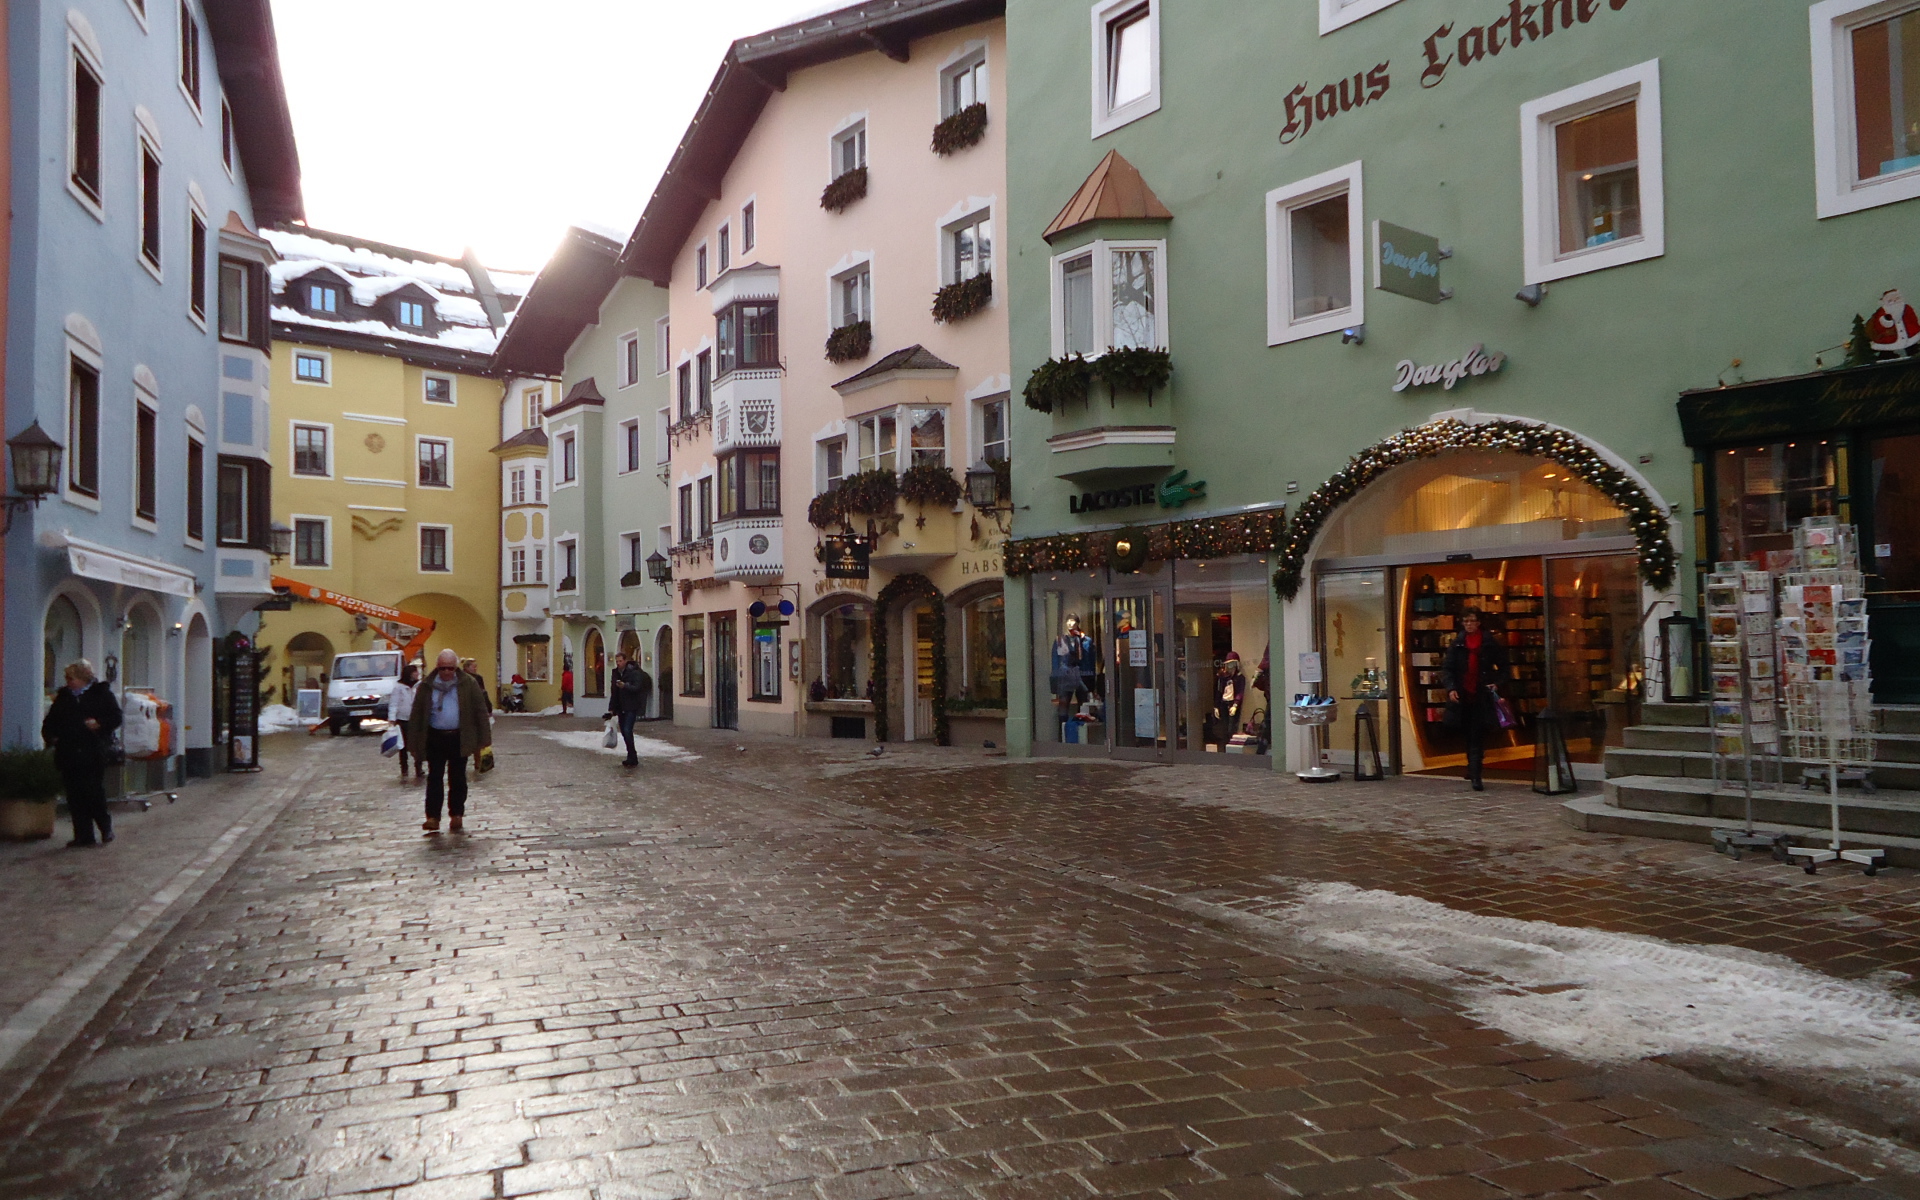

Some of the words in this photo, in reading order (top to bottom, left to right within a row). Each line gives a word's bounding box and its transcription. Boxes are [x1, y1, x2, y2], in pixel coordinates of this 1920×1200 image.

[1279, 60, 1390, 145] Haus
[1382, 241, 1438, 278] Douglas
[1392, 343, 1507, 392] Douglas
[1069, 483, 1156, 514] LACOSTE
[325, 591, 400, 617] STADTWERKE
